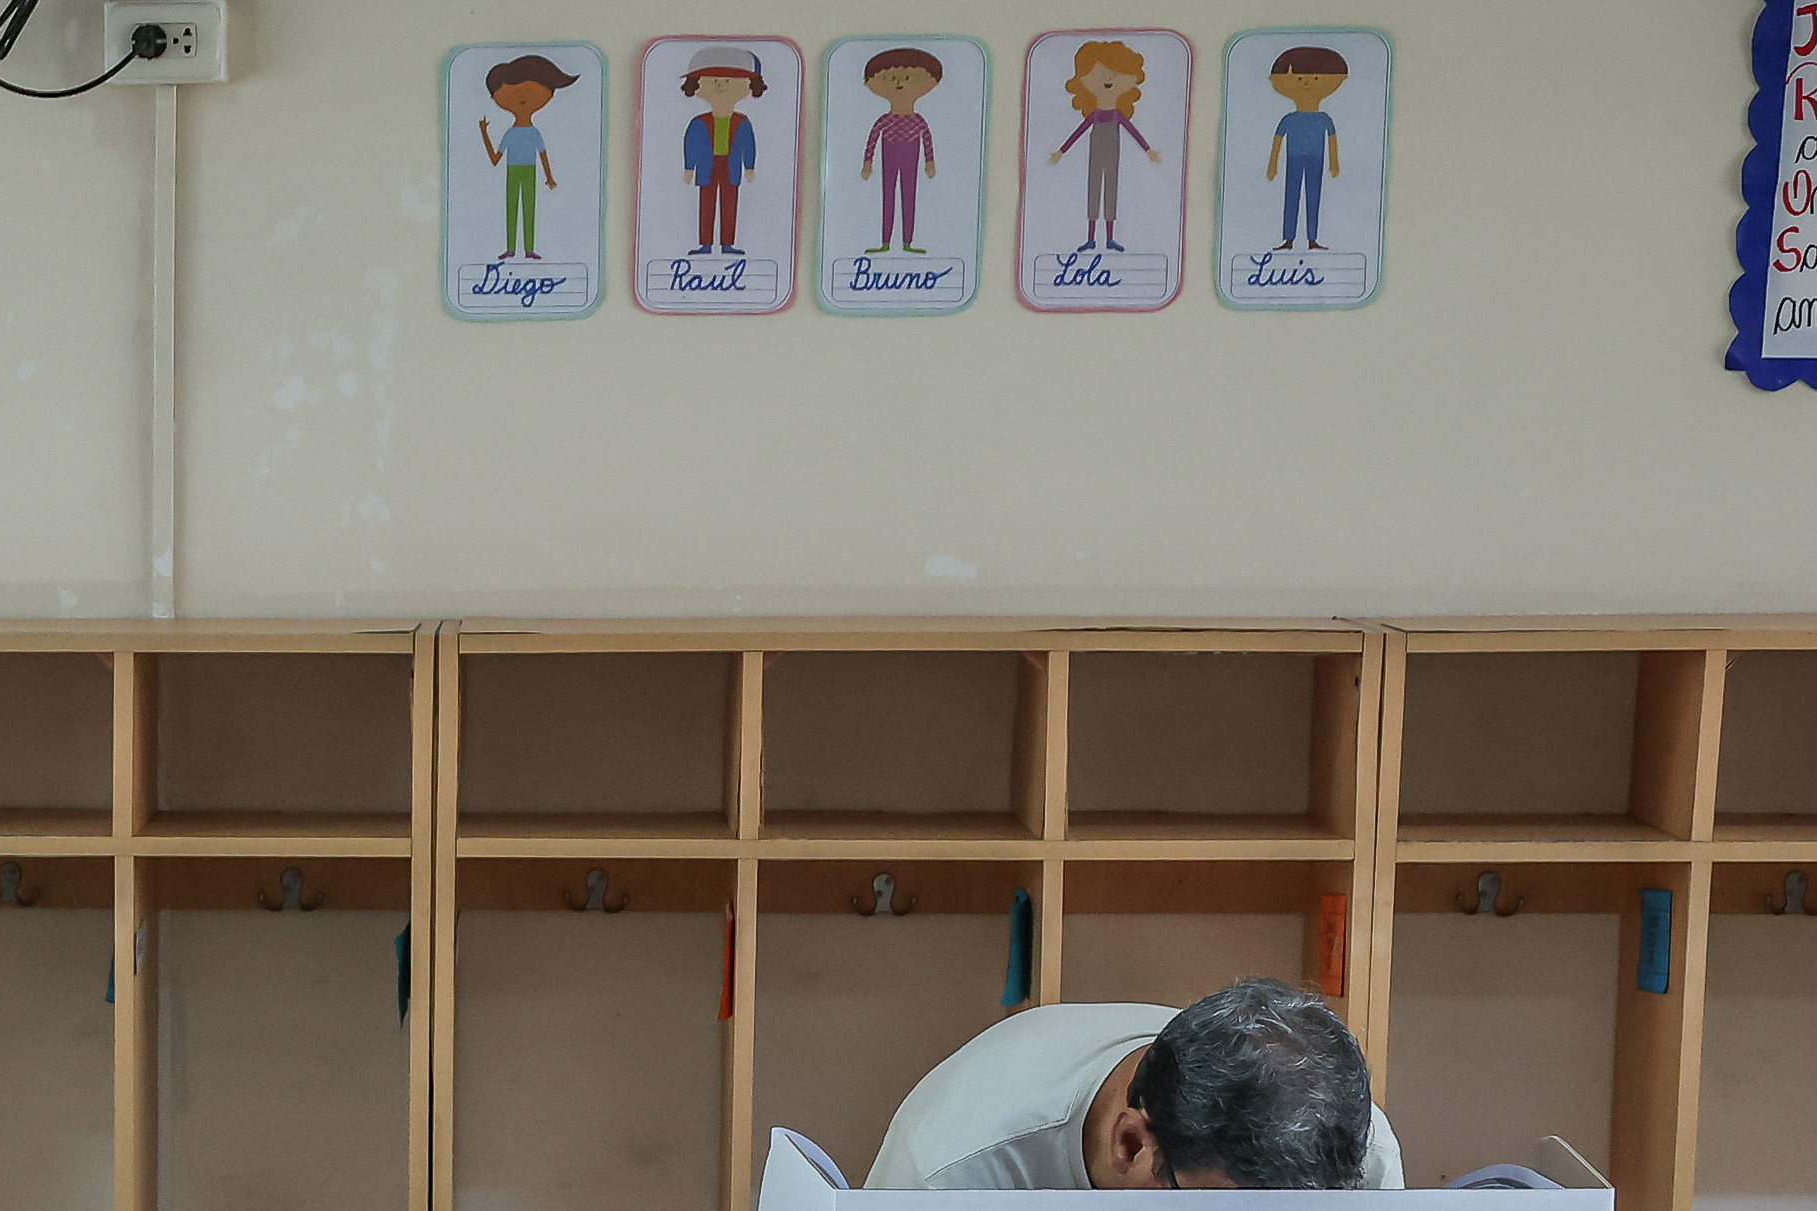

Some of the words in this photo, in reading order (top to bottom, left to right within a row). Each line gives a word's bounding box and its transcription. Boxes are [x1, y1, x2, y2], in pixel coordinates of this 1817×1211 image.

[472, 261, 566, 307] Diego
[670, 258, 747, 291] Raúl
[850, 256, 953, 290] Bruno
[1053, 252, 1122, 287] Lola
[1247, 252, 1325, 287] Luis
